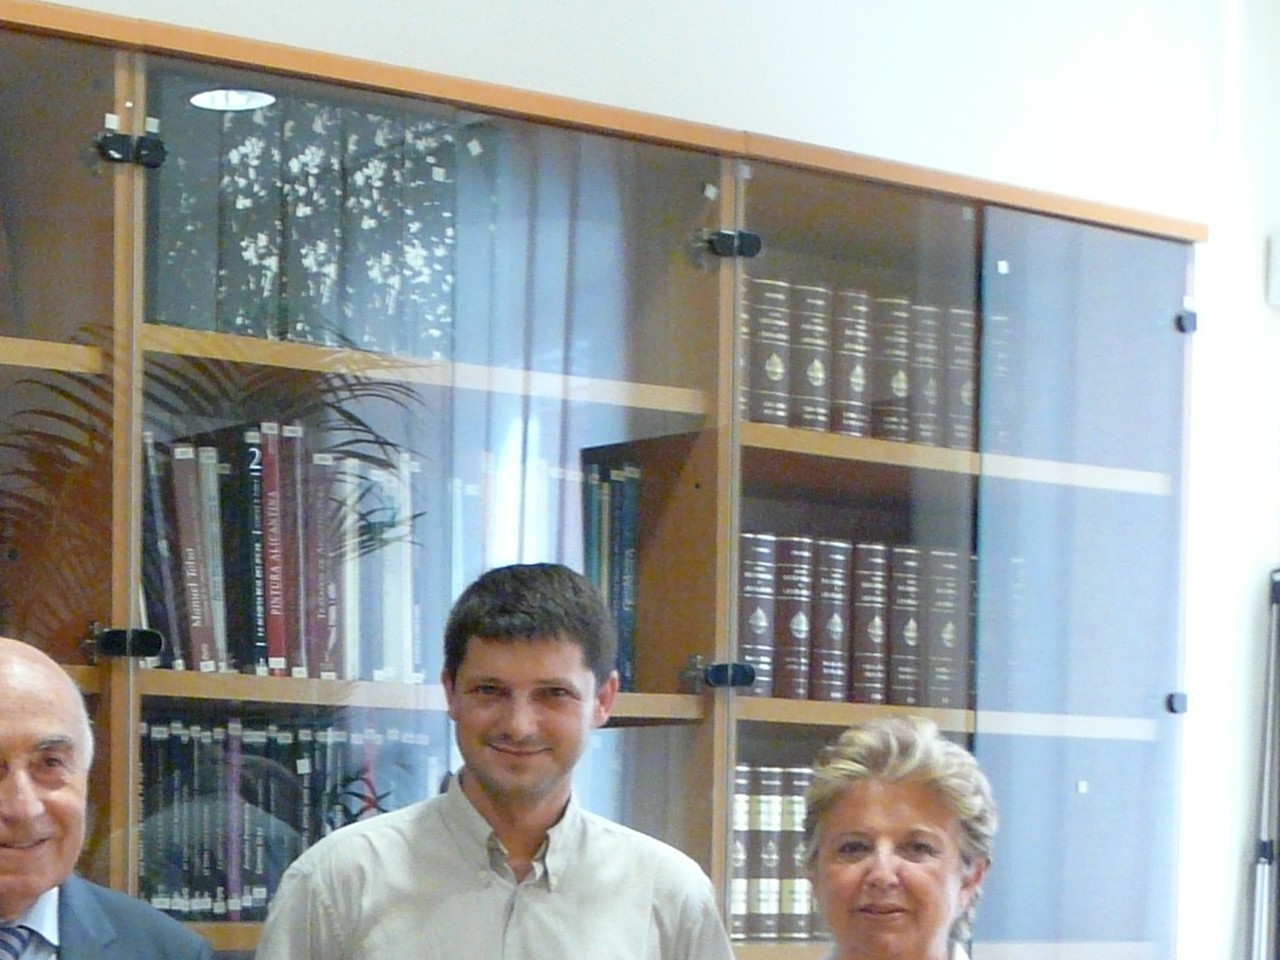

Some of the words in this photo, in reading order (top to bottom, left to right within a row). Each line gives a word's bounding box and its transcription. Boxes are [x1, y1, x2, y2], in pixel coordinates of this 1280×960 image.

[249, 447, 263, 470] 2
[267, 490, 281, 566] ALICANTINA
[186, 582, 203, 628] Manuel
[270, 566, 283, 616] PINTURA
